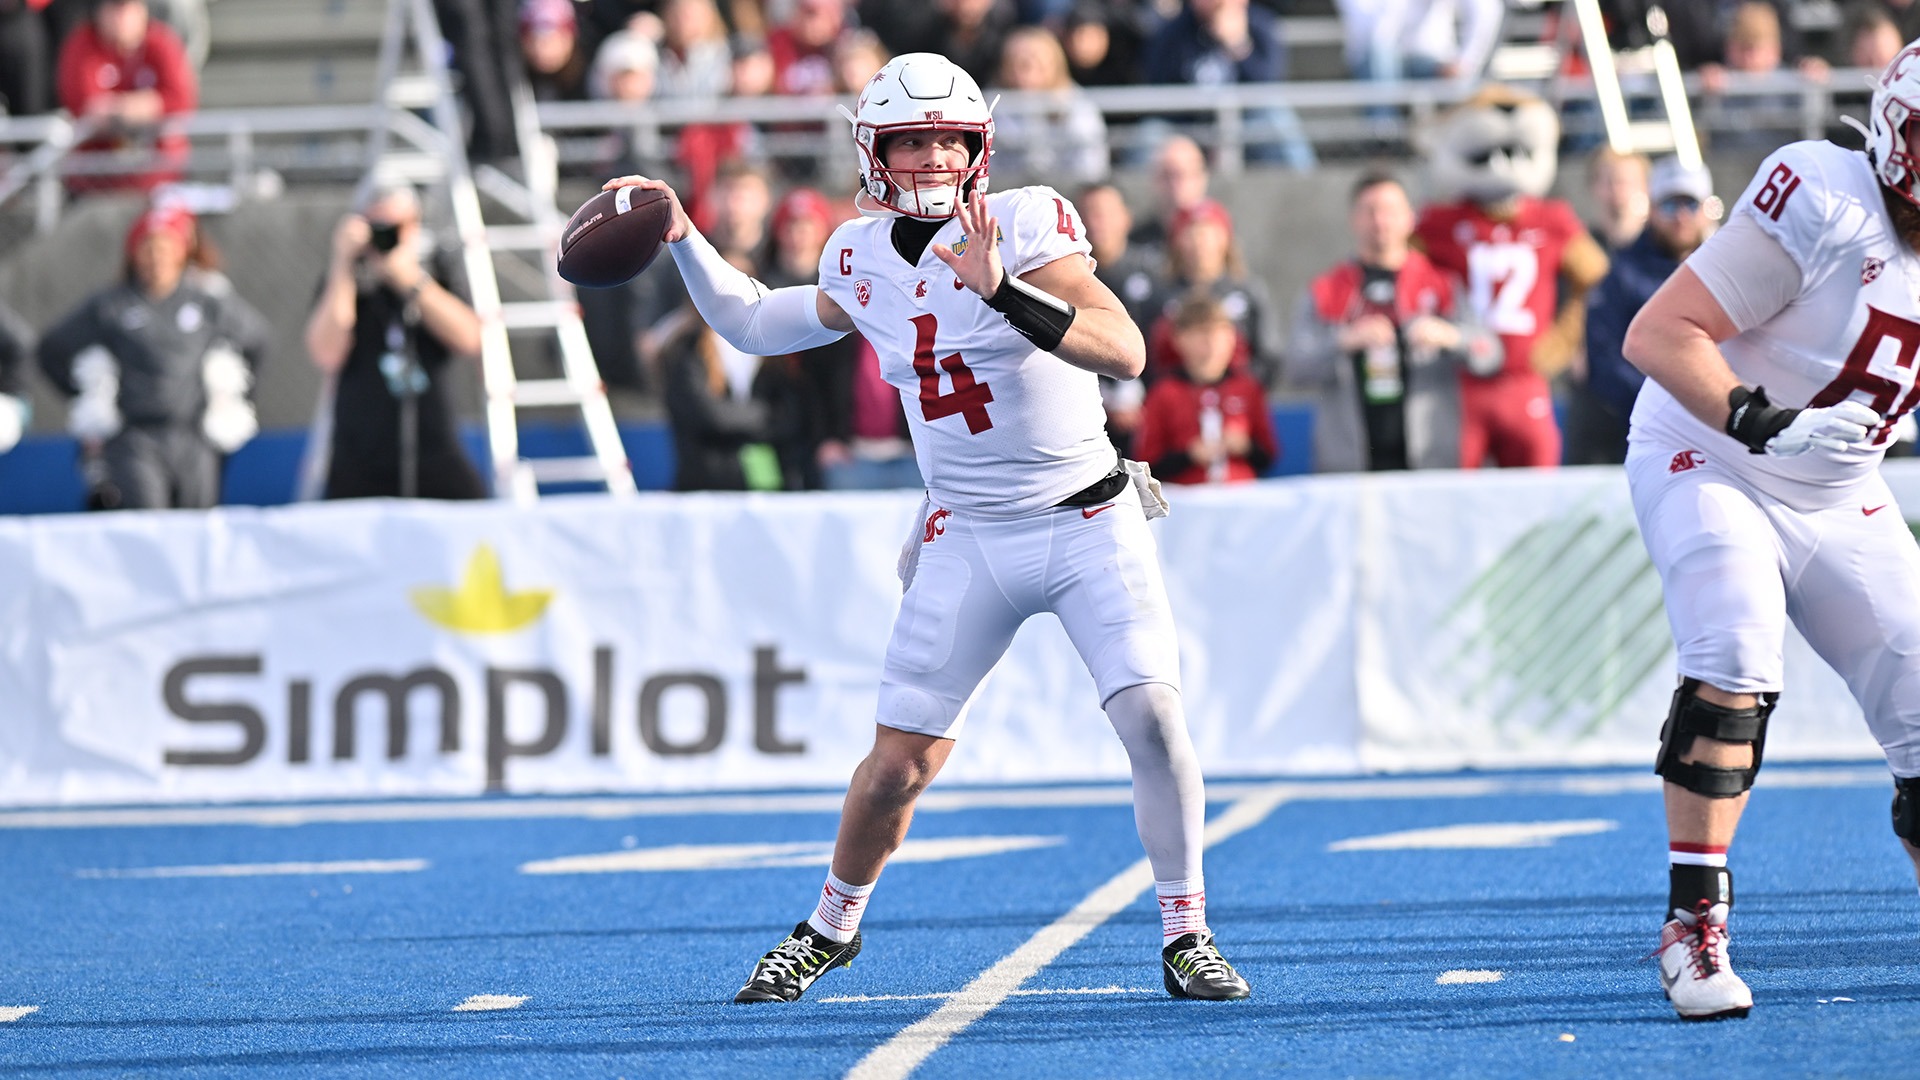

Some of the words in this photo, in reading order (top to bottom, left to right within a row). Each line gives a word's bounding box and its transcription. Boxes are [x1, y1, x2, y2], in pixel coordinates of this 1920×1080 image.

[924, 110, 943, 120] WSU
[1753, 162, 1802, 222] 61
[1052, 198, 1078, 241] 4
[840, 248, 853, 276] C
[907, 313, 994, 435] 4
[161, 643, 808, 790] Simplot
